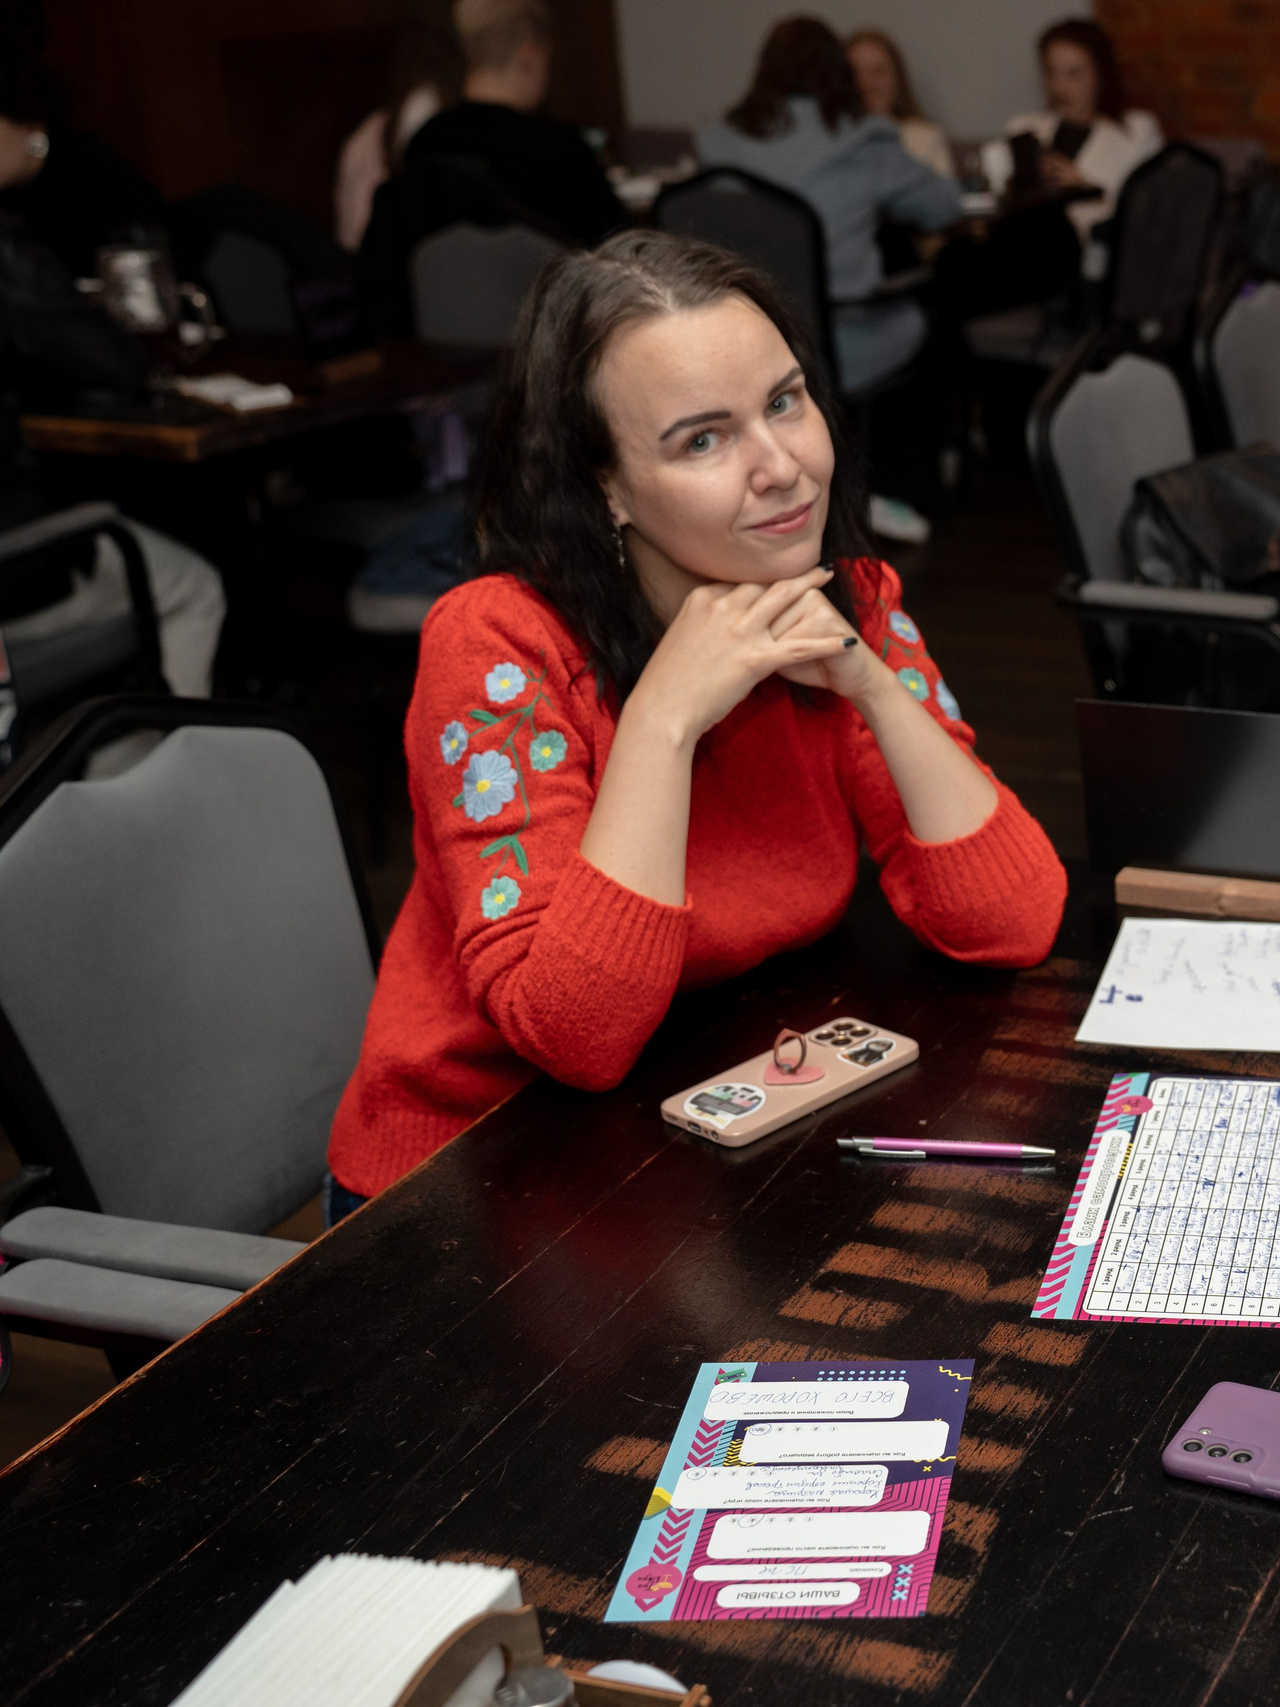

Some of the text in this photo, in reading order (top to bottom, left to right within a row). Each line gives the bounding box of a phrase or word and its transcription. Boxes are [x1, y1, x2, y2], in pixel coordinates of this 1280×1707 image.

[1075, 1206, 1100, 1238] Бланк
[1112, 1238, 1123, 1252] раунд
[1103, 1267, 1115, 1282] раунд
[709, 1390, 895, 1405] ВСЕГО ХОРОШЕВО
[736, 1590, 841, 1600] ВАШИ ОТЗЫВЫ
